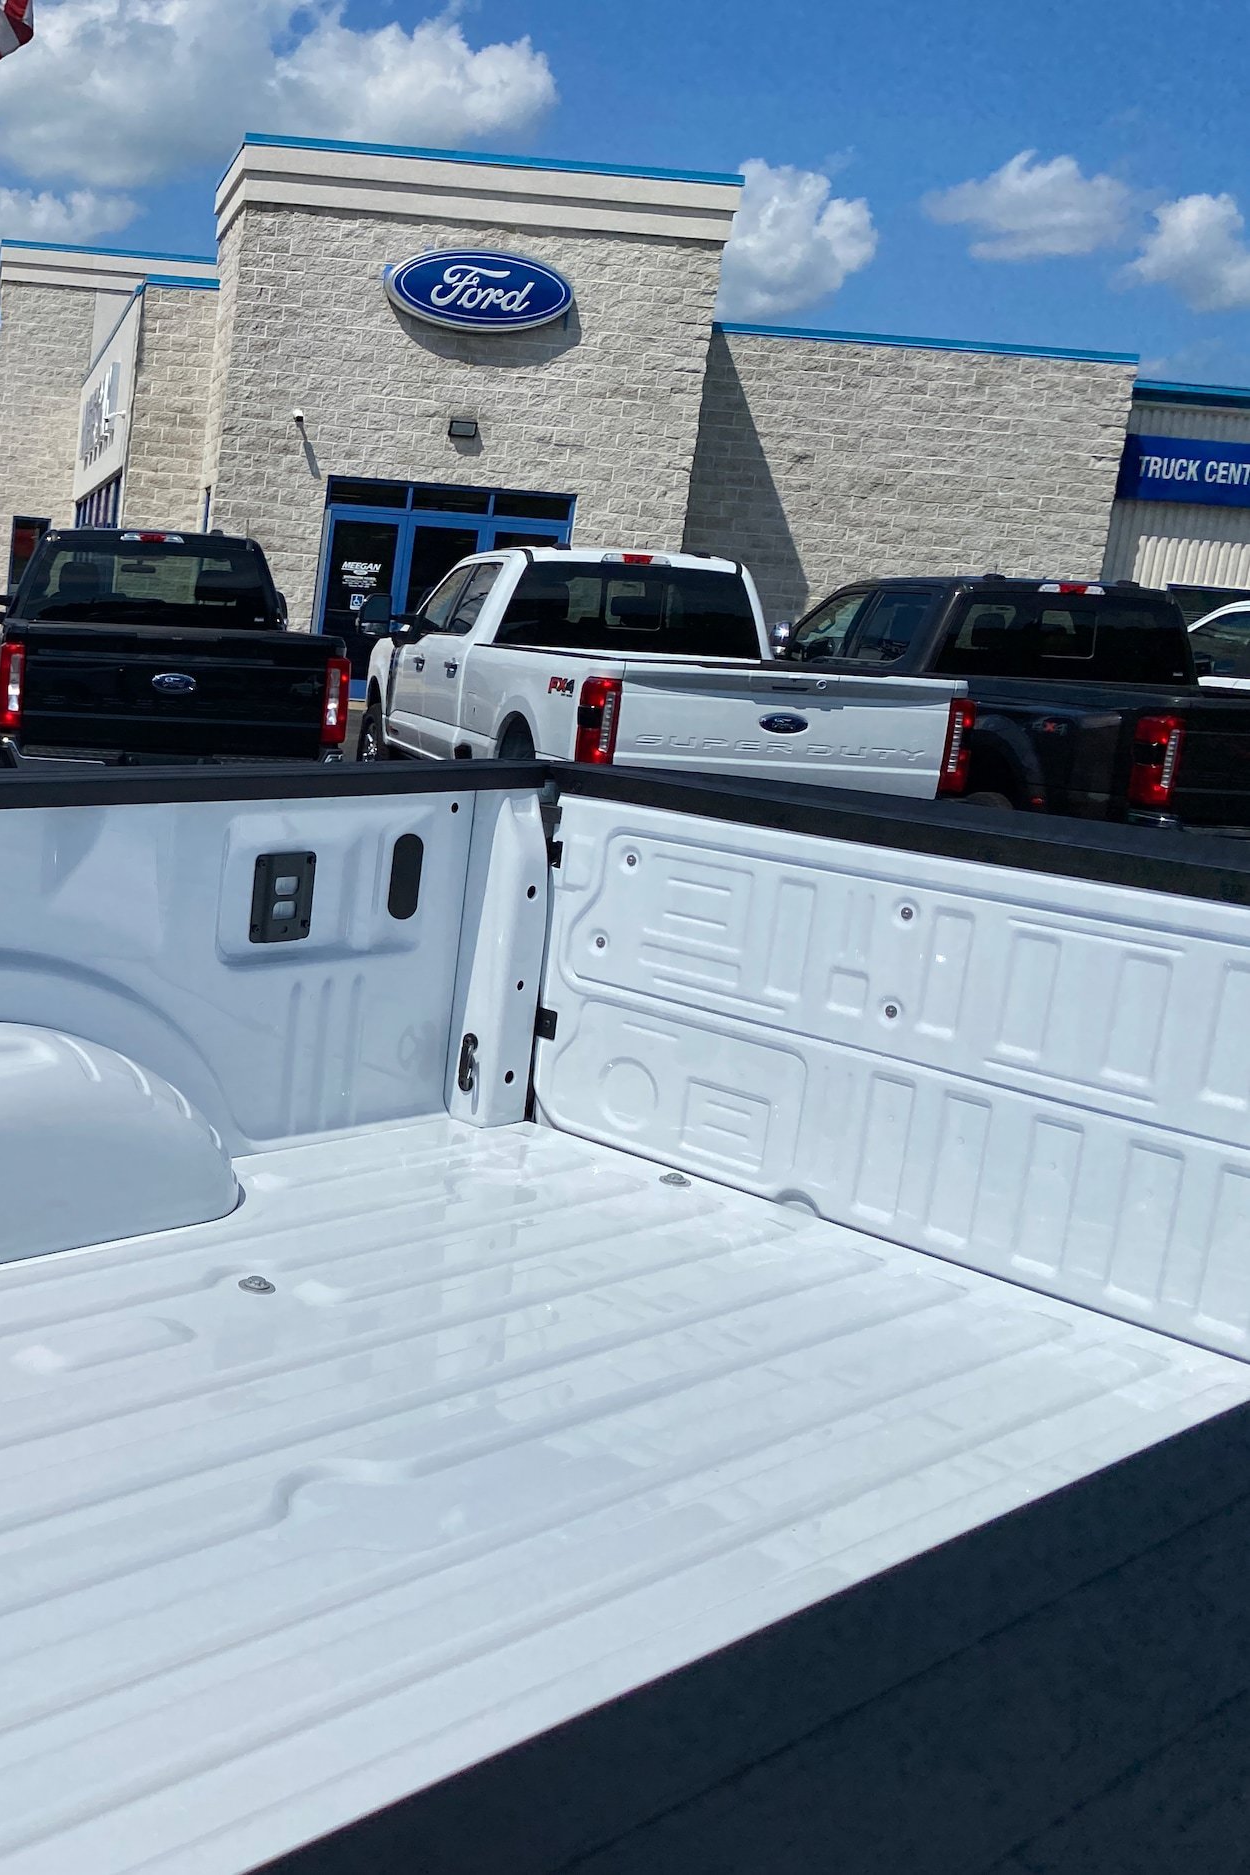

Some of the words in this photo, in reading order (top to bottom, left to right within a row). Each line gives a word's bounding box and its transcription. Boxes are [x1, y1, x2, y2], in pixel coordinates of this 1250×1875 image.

[430, 264, 536, 312] Ford
[1139, 456, 1202, 482] TRUCK
[1204, 460, 1250, 486] CENT
[548, 676, 575, 695] FX4
[635, 733, 796, 756] SUPER
[805, 743, 925, 762] DUTY
